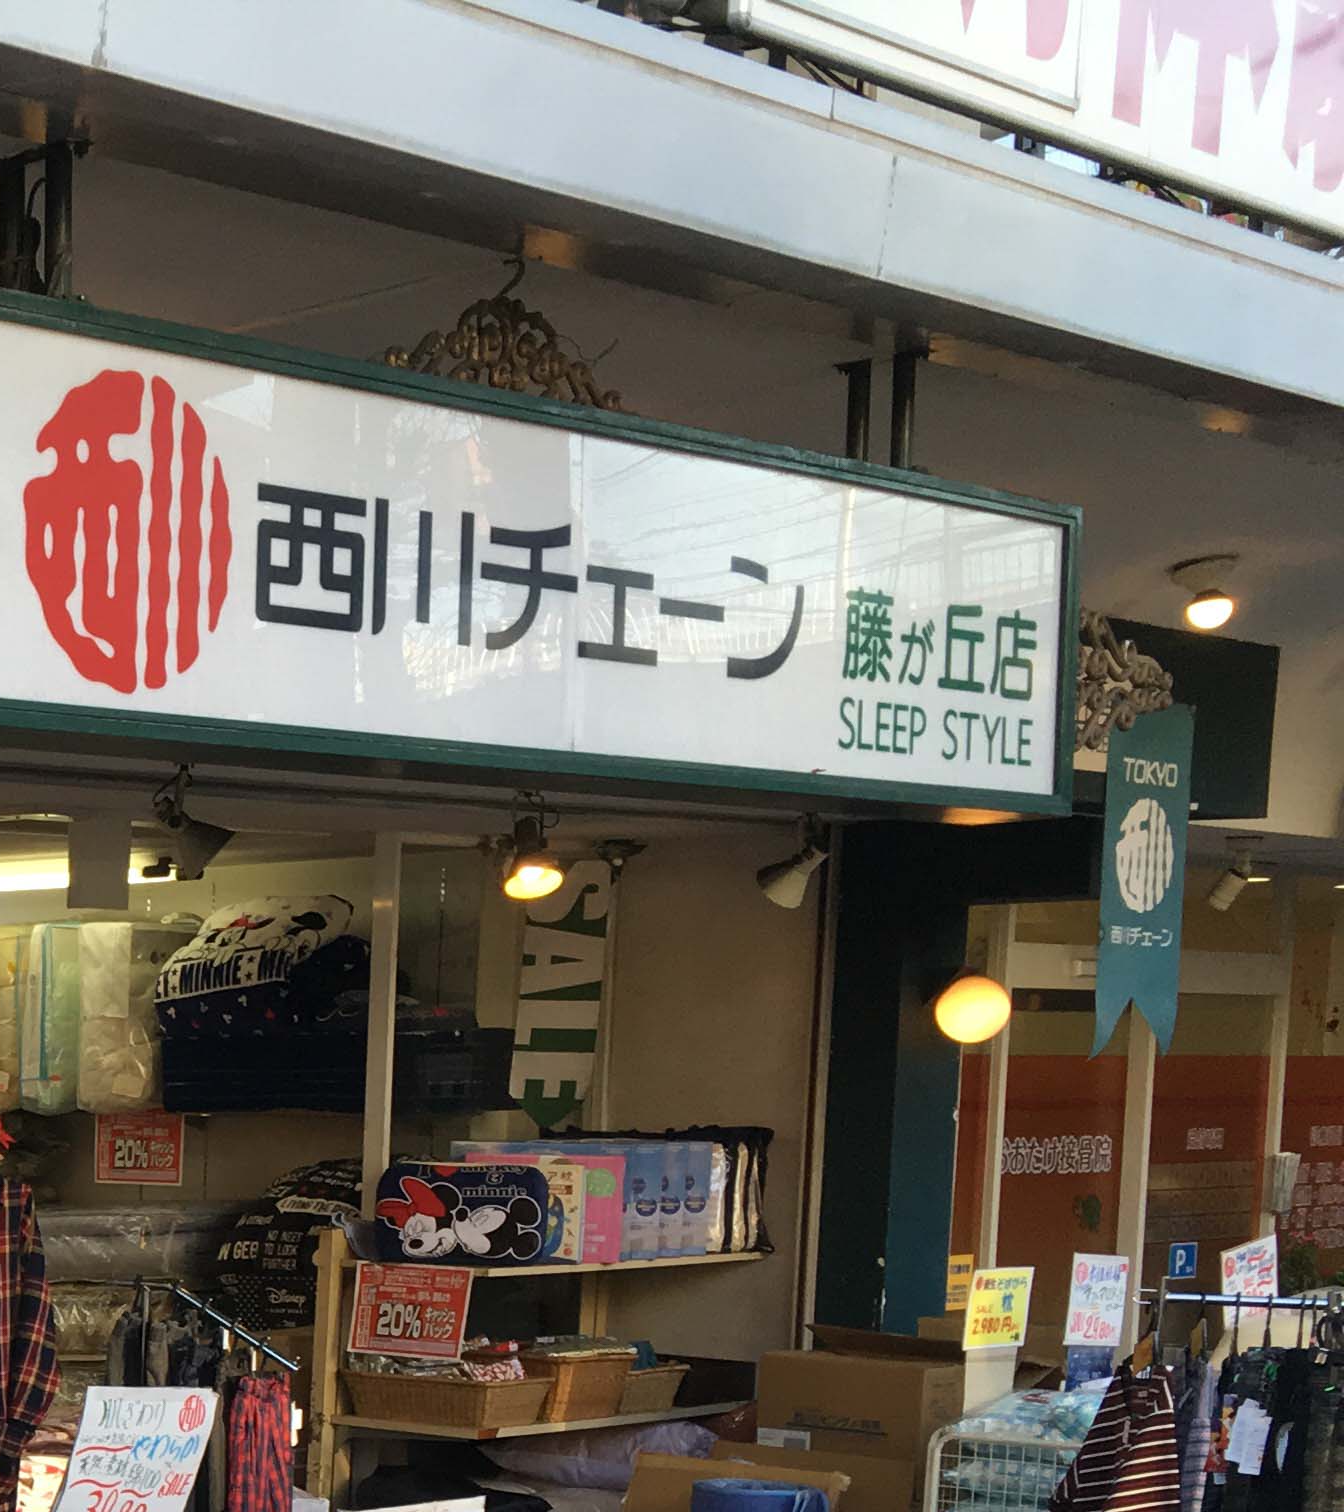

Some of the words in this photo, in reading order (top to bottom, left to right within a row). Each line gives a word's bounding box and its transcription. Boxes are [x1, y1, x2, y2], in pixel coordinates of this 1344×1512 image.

[254, 481, 805, 680] 西川チェーン
[842, 586, 1038, 702] 藤が丘店
[838, 696, 927, 756] SLEEP
[942, 709, 1033, 767] STYLE
[1123, 757, 1178, 788] TOKYO
[1110, 925, 1173, 947] 西川チェーン
[180, 954, 242, 996] MINNIE
[114, 1139, 148, 1168] 20%
[1175, 1250, 1186, 1274] P
[264, 1287, 306, 1307] Disney
[377, 1303, 421, 1338] 20%
[157, 1471, 194, 1497] SALE
